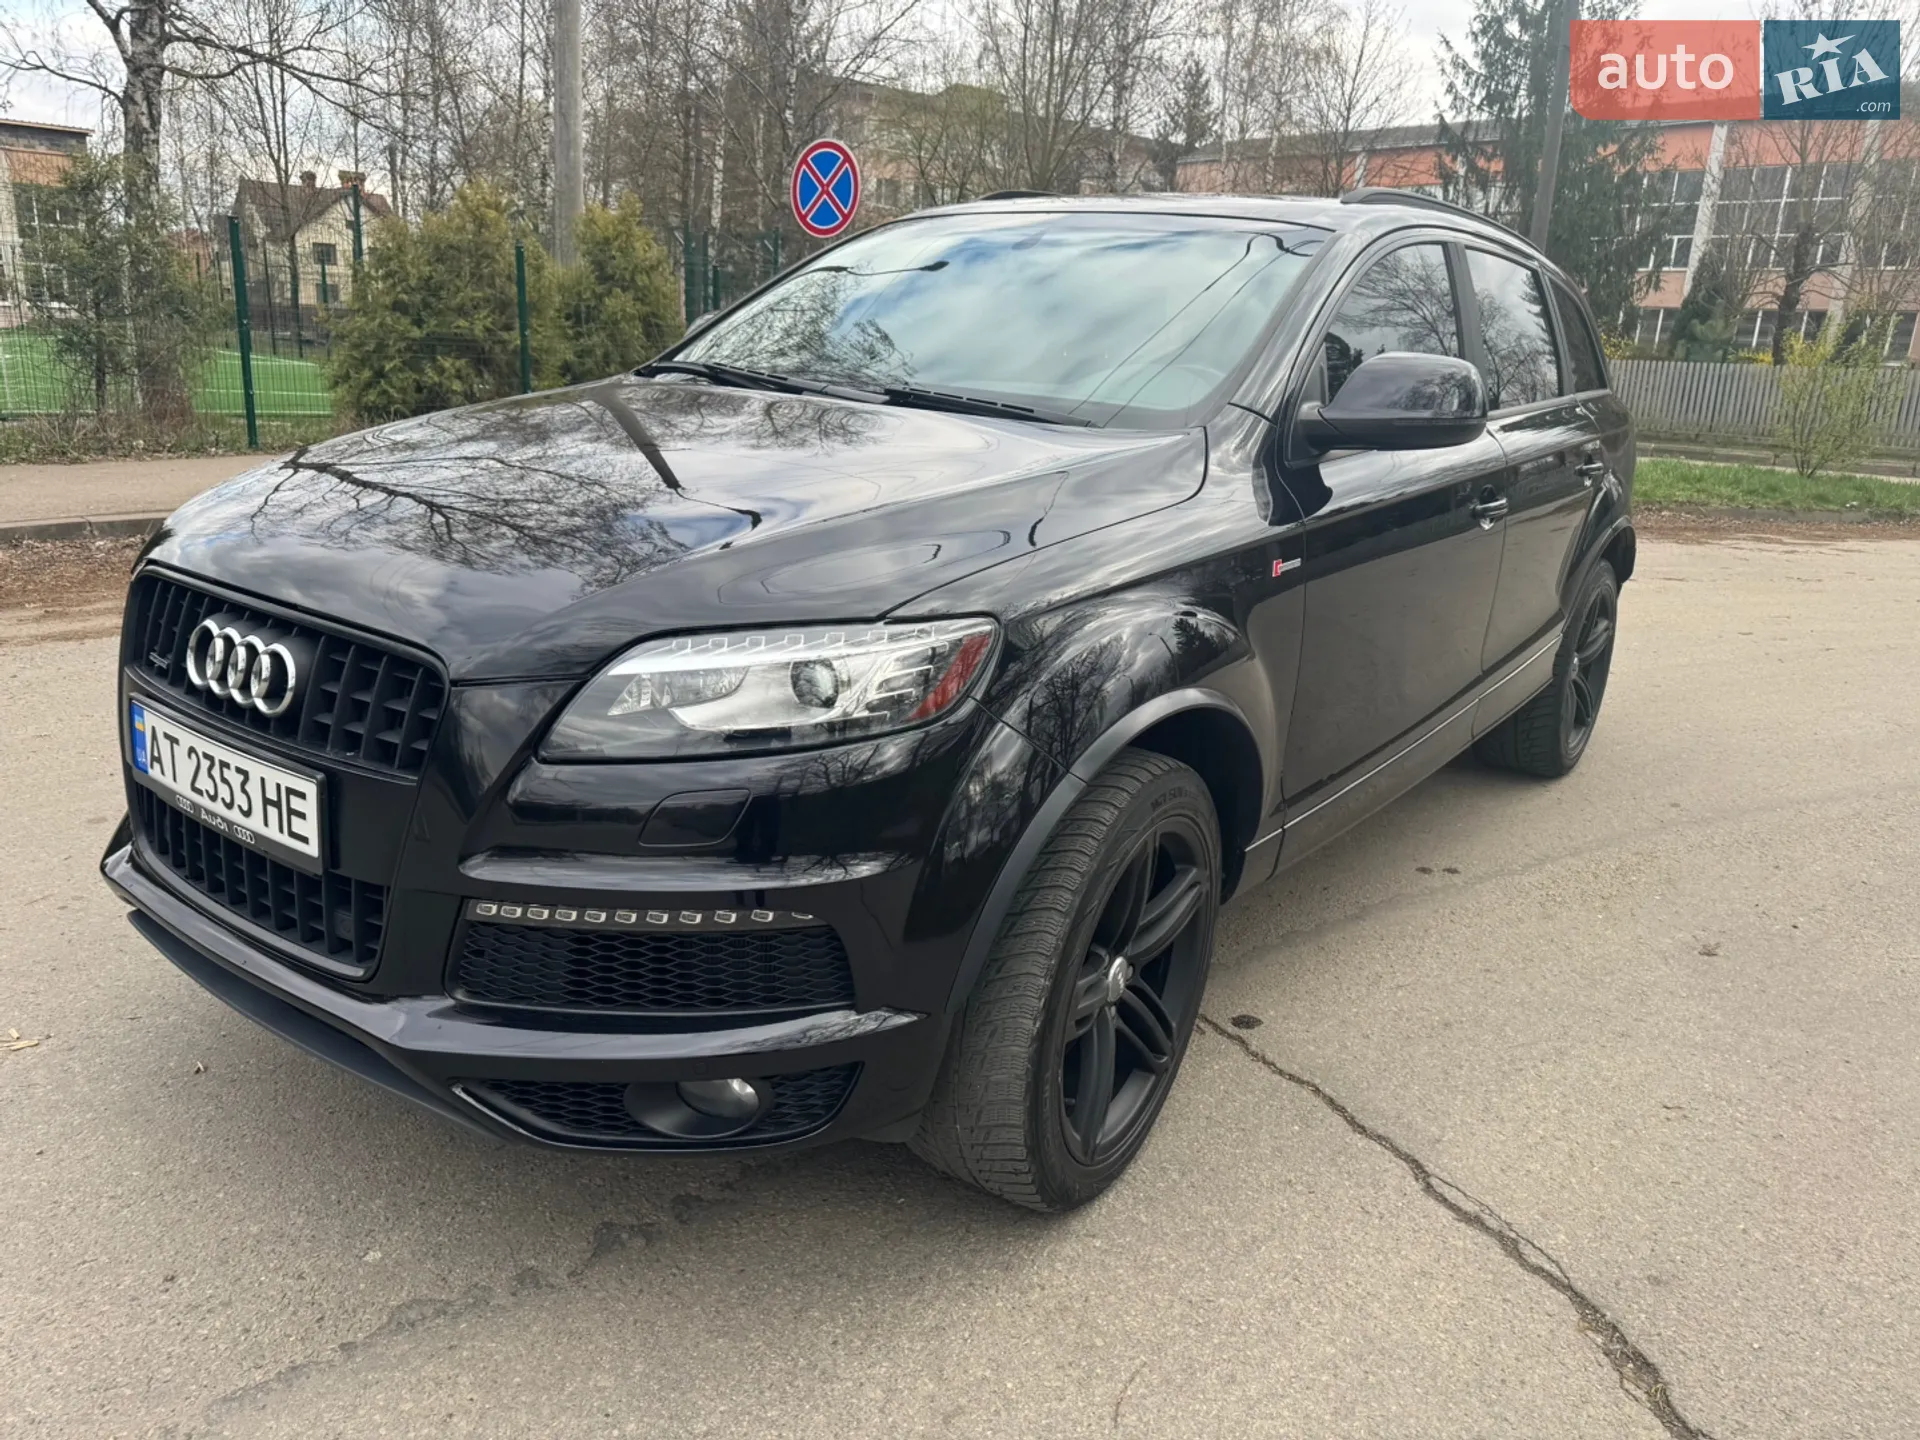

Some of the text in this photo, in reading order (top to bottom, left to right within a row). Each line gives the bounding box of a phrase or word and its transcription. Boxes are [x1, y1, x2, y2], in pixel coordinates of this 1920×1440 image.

[150, 725, 310, 845] AT 2353 HE
